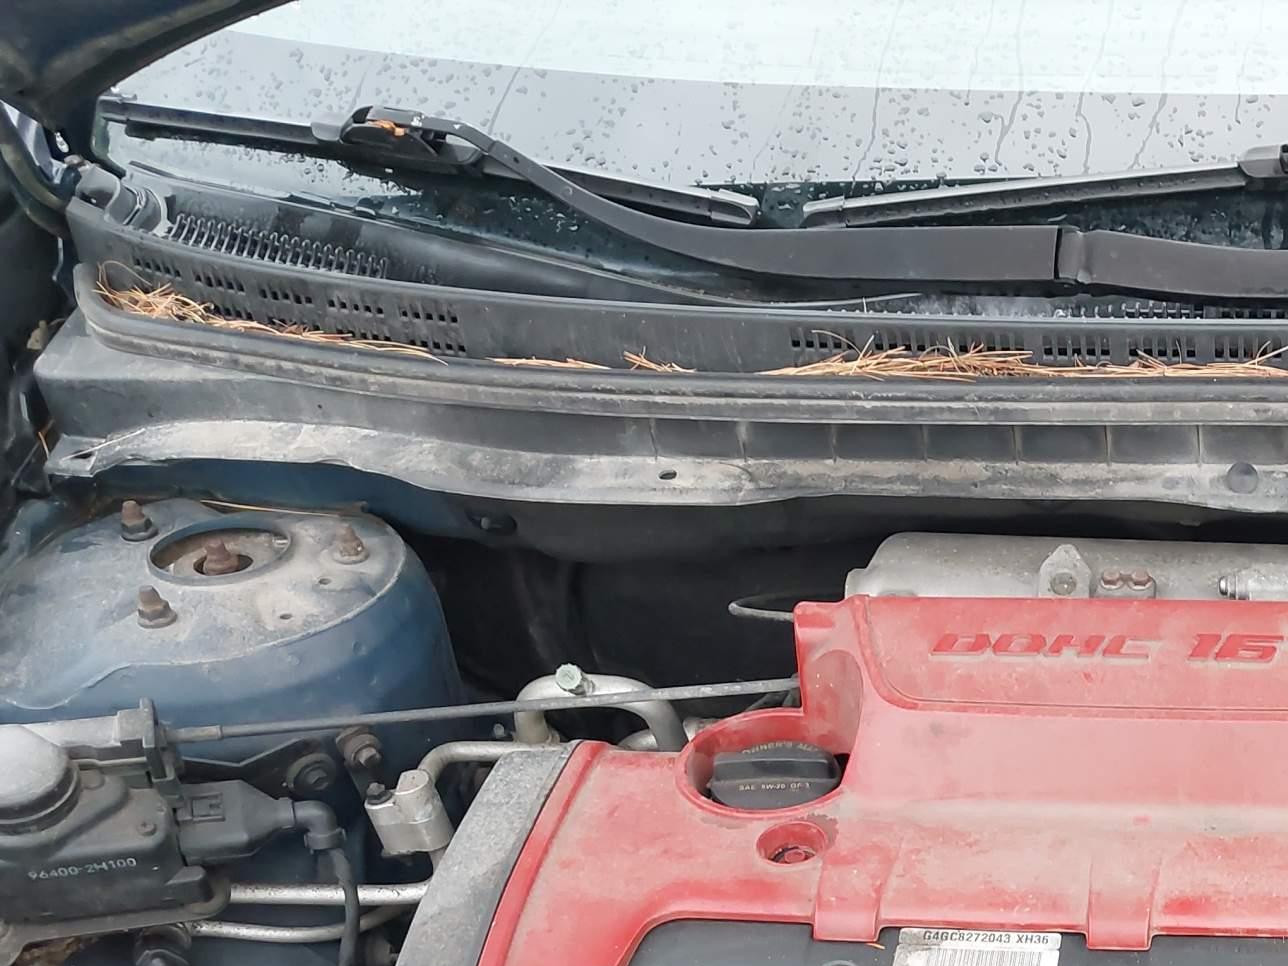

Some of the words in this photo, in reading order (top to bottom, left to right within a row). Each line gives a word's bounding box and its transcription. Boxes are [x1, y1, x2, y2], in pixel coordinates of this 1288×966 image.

[928, 633, 1162, 660] DOHC
[28, 857, 137, 880] 96400-2H100
[923, 930, 1011, 944] G4GC8272043
[1016, 934, 1049, 945] XH36
